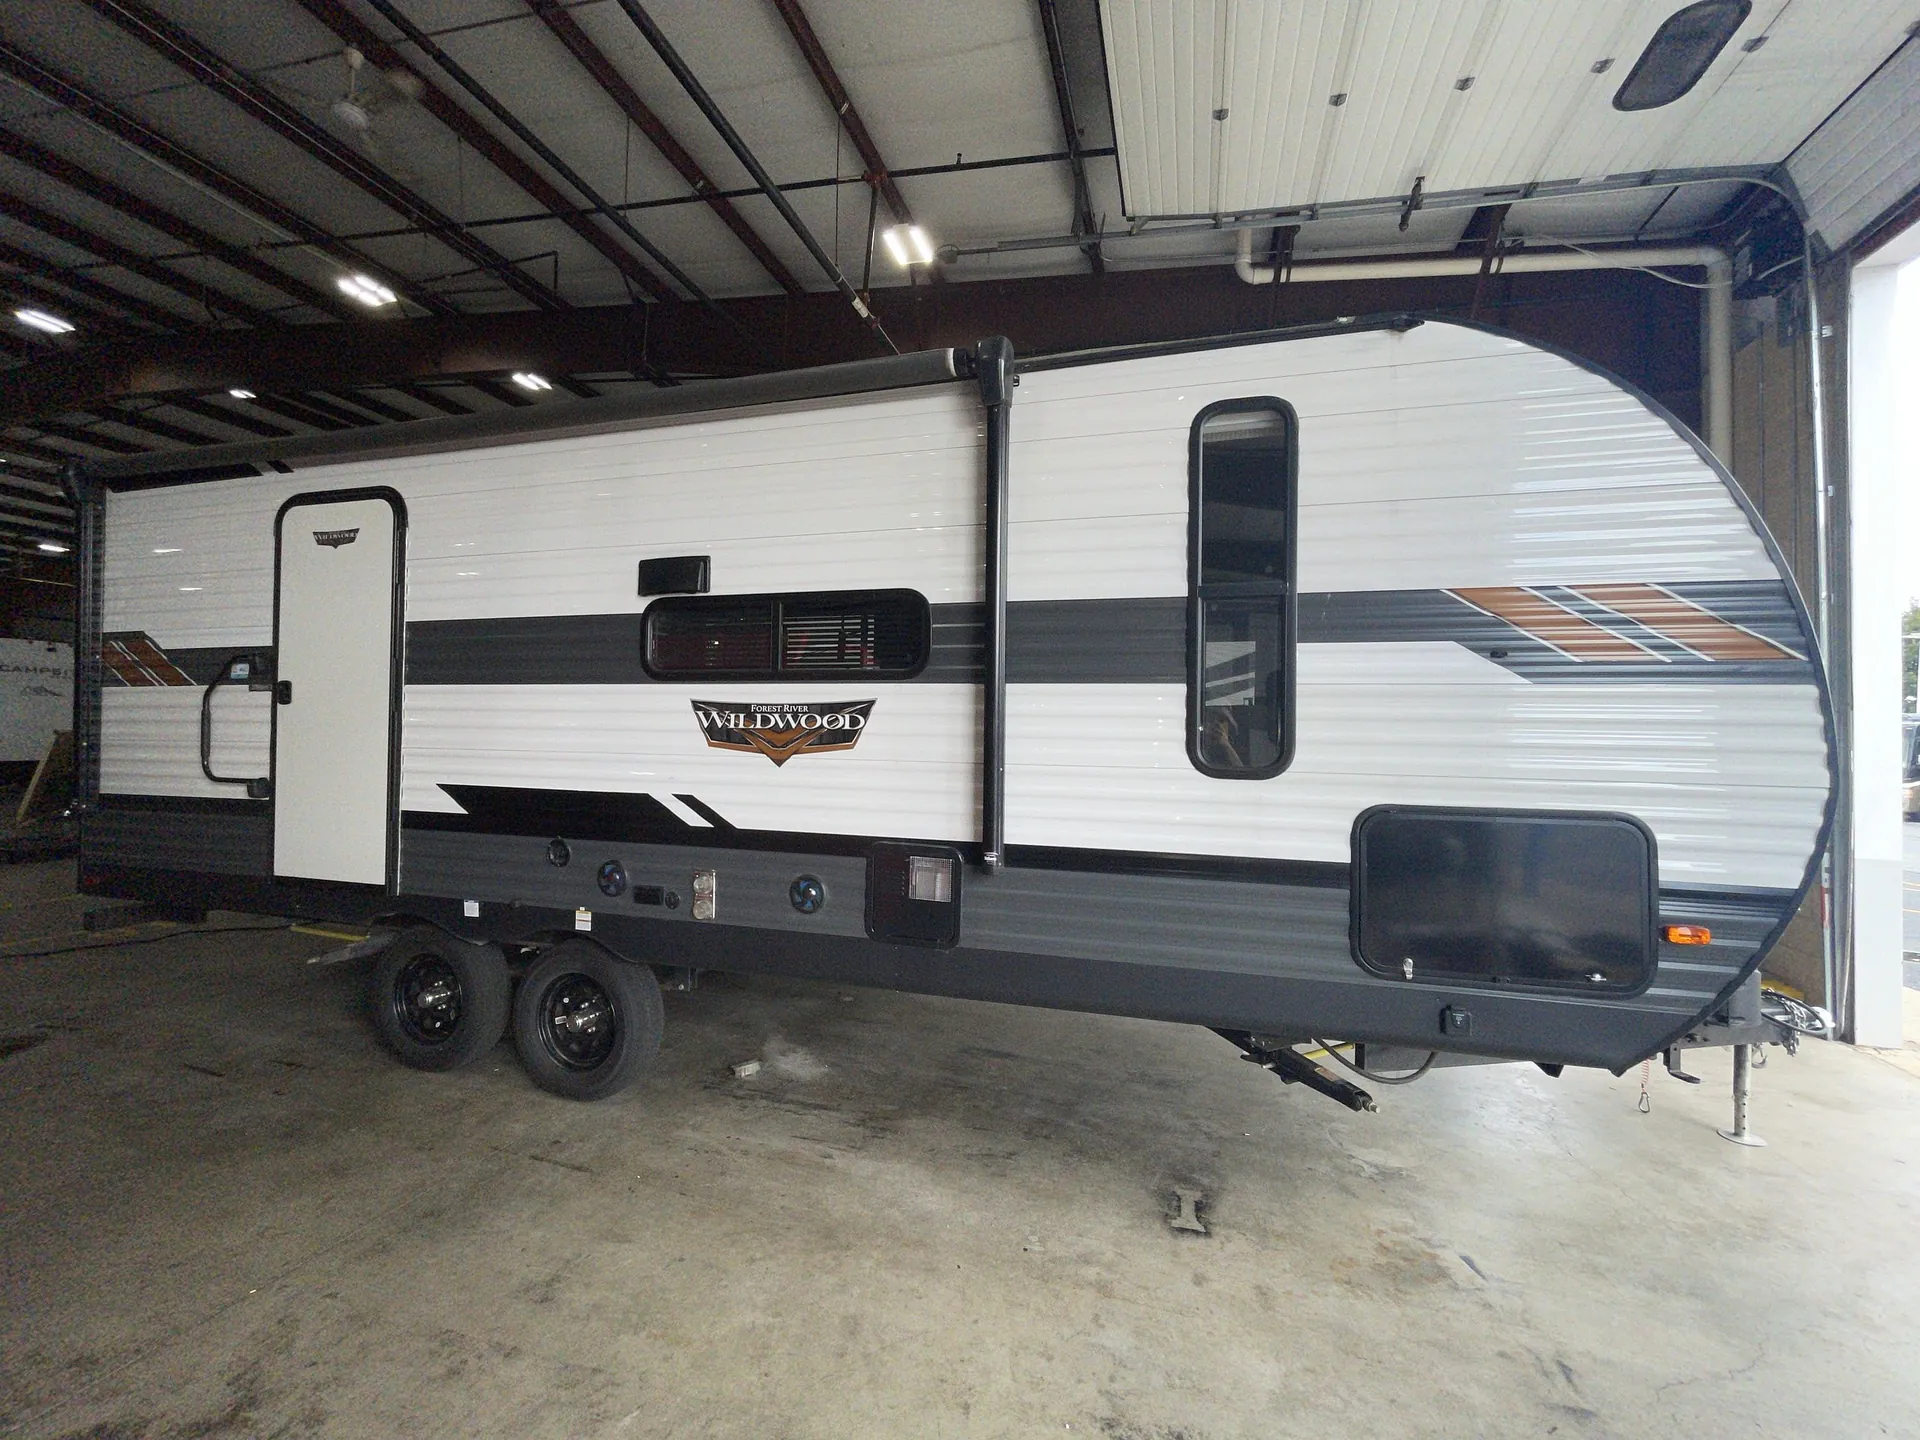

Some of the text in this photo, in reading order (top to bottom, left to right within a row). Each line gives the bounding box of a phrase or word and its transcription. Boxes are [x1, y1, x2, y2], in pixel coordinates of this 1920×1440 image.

[751, 704, 809, 712] FOREST RIVER
[695, 710, 866, 730] WILDWOOD
